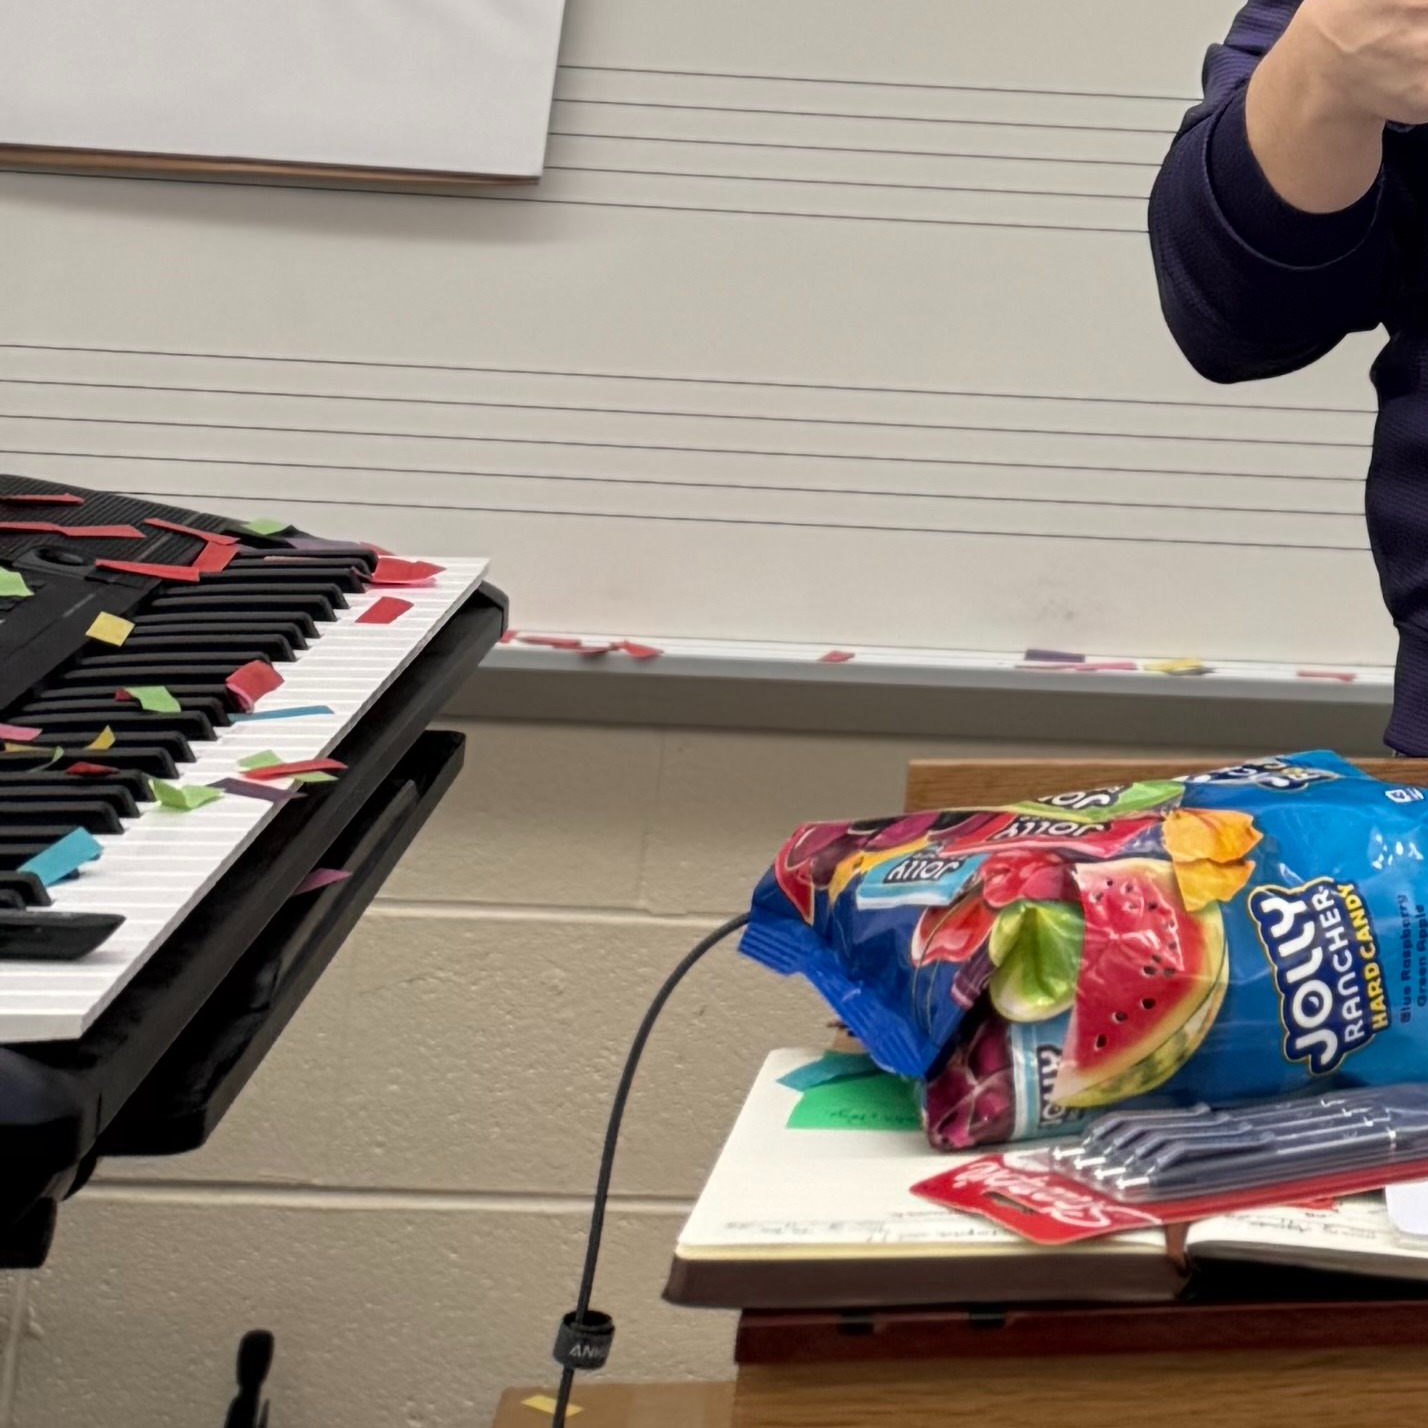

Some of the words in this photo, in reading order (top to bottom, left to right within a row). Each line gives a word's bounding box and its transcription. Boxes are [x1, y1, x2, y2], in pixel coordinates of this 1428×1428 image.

[888, 858, 957, 881] JOLLY
[1337, 884, 1376, 959] CANDY
[1416, 905, 1428, 957] Apple
[1260, 897, 1338, 1066] JOLLY
[1311, 888, 1365, 1042] RANCHER
[1362, 962, 1388, 1030] HARD
[1417, 961, 1427, 1007] Green
